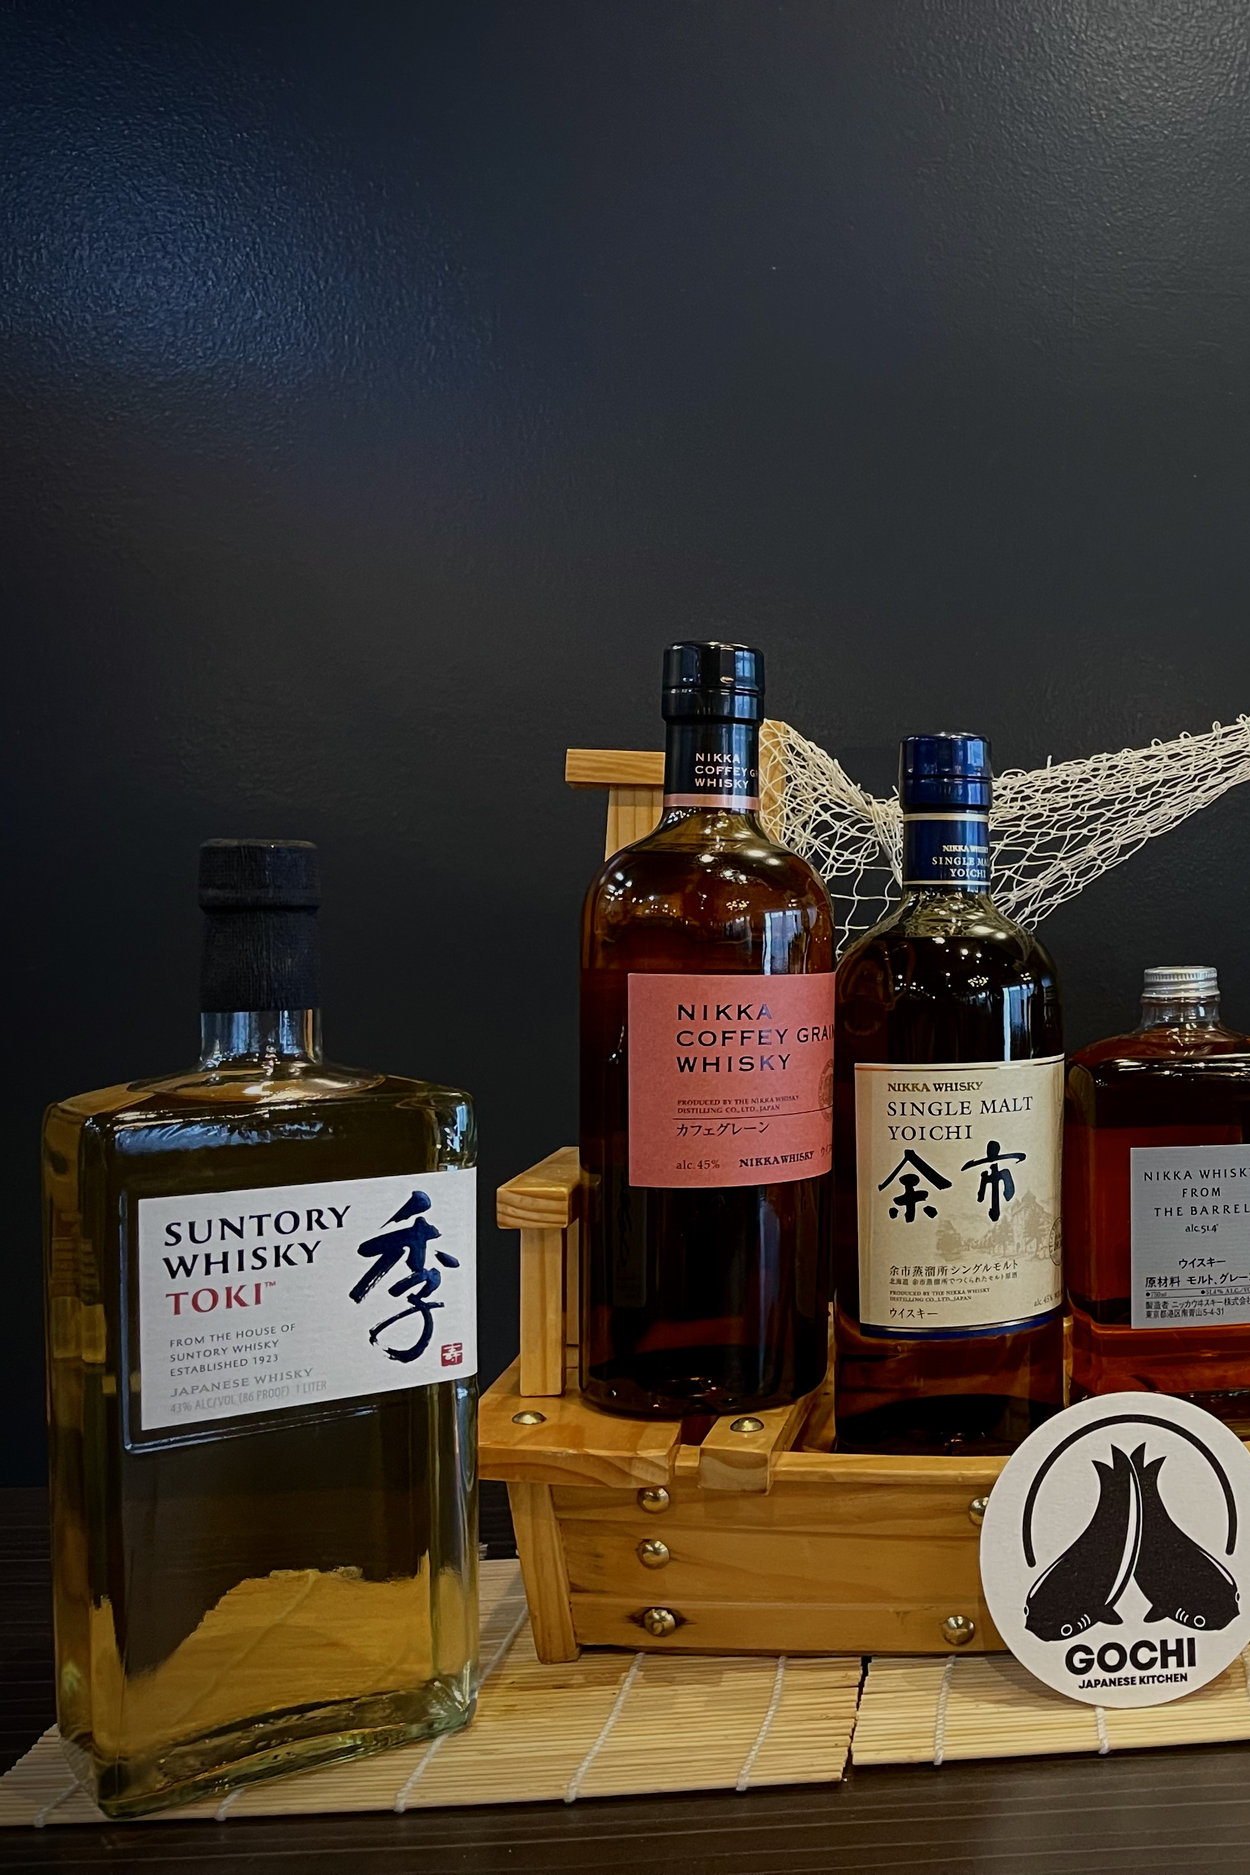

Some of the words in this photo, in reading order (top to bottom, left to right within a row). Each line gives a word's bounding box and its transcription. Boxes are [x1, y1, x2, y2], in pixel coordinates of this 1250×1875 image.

[695, 752, 741, 763] NIKKA
[695, 765, 747, 777] COFFEY
[695, 778, 749, 789] WHISKY
[931, 856, 975, 866] SINGLE
[950, 868, 986, 879] YOICHI
[677, 1003, 773, 1021] NIKKA
[676, 1028, 788, 1047] COFFEY
[676, 1053, 791, 1073] WHISKY
[887, 1083, 930, 1092] NIKKA
[933, 1081, 983, 1092] WHISKY
[751, 1097, 774, 1105] NIKKA
[760, 1104, 780, 1112] JAPAN
[887, 1101, 972, 1116] SINGLE
[980, 1096, 1033, 1114] MALT
[676, 1121, 770, 1138] カフェグレーン
[887, 1125, 973, 1140] YOICHI
[1144, 1170, 1193, 1181] NIKKA
[1182, 1187, 1221, 1198] FROM
[1154, 1207, 1183, 1217] THE
[1190, 1203, 1250, 1216] BARREL
[164, 1205, 352, 1247] SUNTORY
[162, 1240, 322, 1280] WHISKY
[1178, 1257, 1226, 1269] ウイスキー
[349, 1190, 460, 1363] 季
[1145, 1275, 1180, 1288] 原材料
[889, 1307, 938, 1320] ウイスキー
[169, 1336, 205, 1348] FROM
[209, 1332, 232, 1342] THE
[235, 1326, 276, 1339] HOUSE
[280, 1323, 296, 1333] OF
[169, 1347, 229, 1363] SUNTORY
[232, 1339, 279, 1354] WHISKY
[170, 1358, 248, 1377] ESTABLISHED
[252, 1353, 278, 1365] 1923
[170, 1377, 250, 1398] JAPANESE
[254, 1367, 314, 1385] WHISKY
[170, 1401, 193, 1414] 43%
[194, 1394, 237, 1411] ALC/VOL
[238, 1391, 255, 1407] (86
[256, 1384, 290, 1402] PROOF)
[302, 1380, 328, 1394] LITER
[1065, 1637, 1197, 1675] GOCHI
[1078, 1676, 1137, 1689] JAPANESE
[1139, 1672, 1189, 1685] KITCHEN
